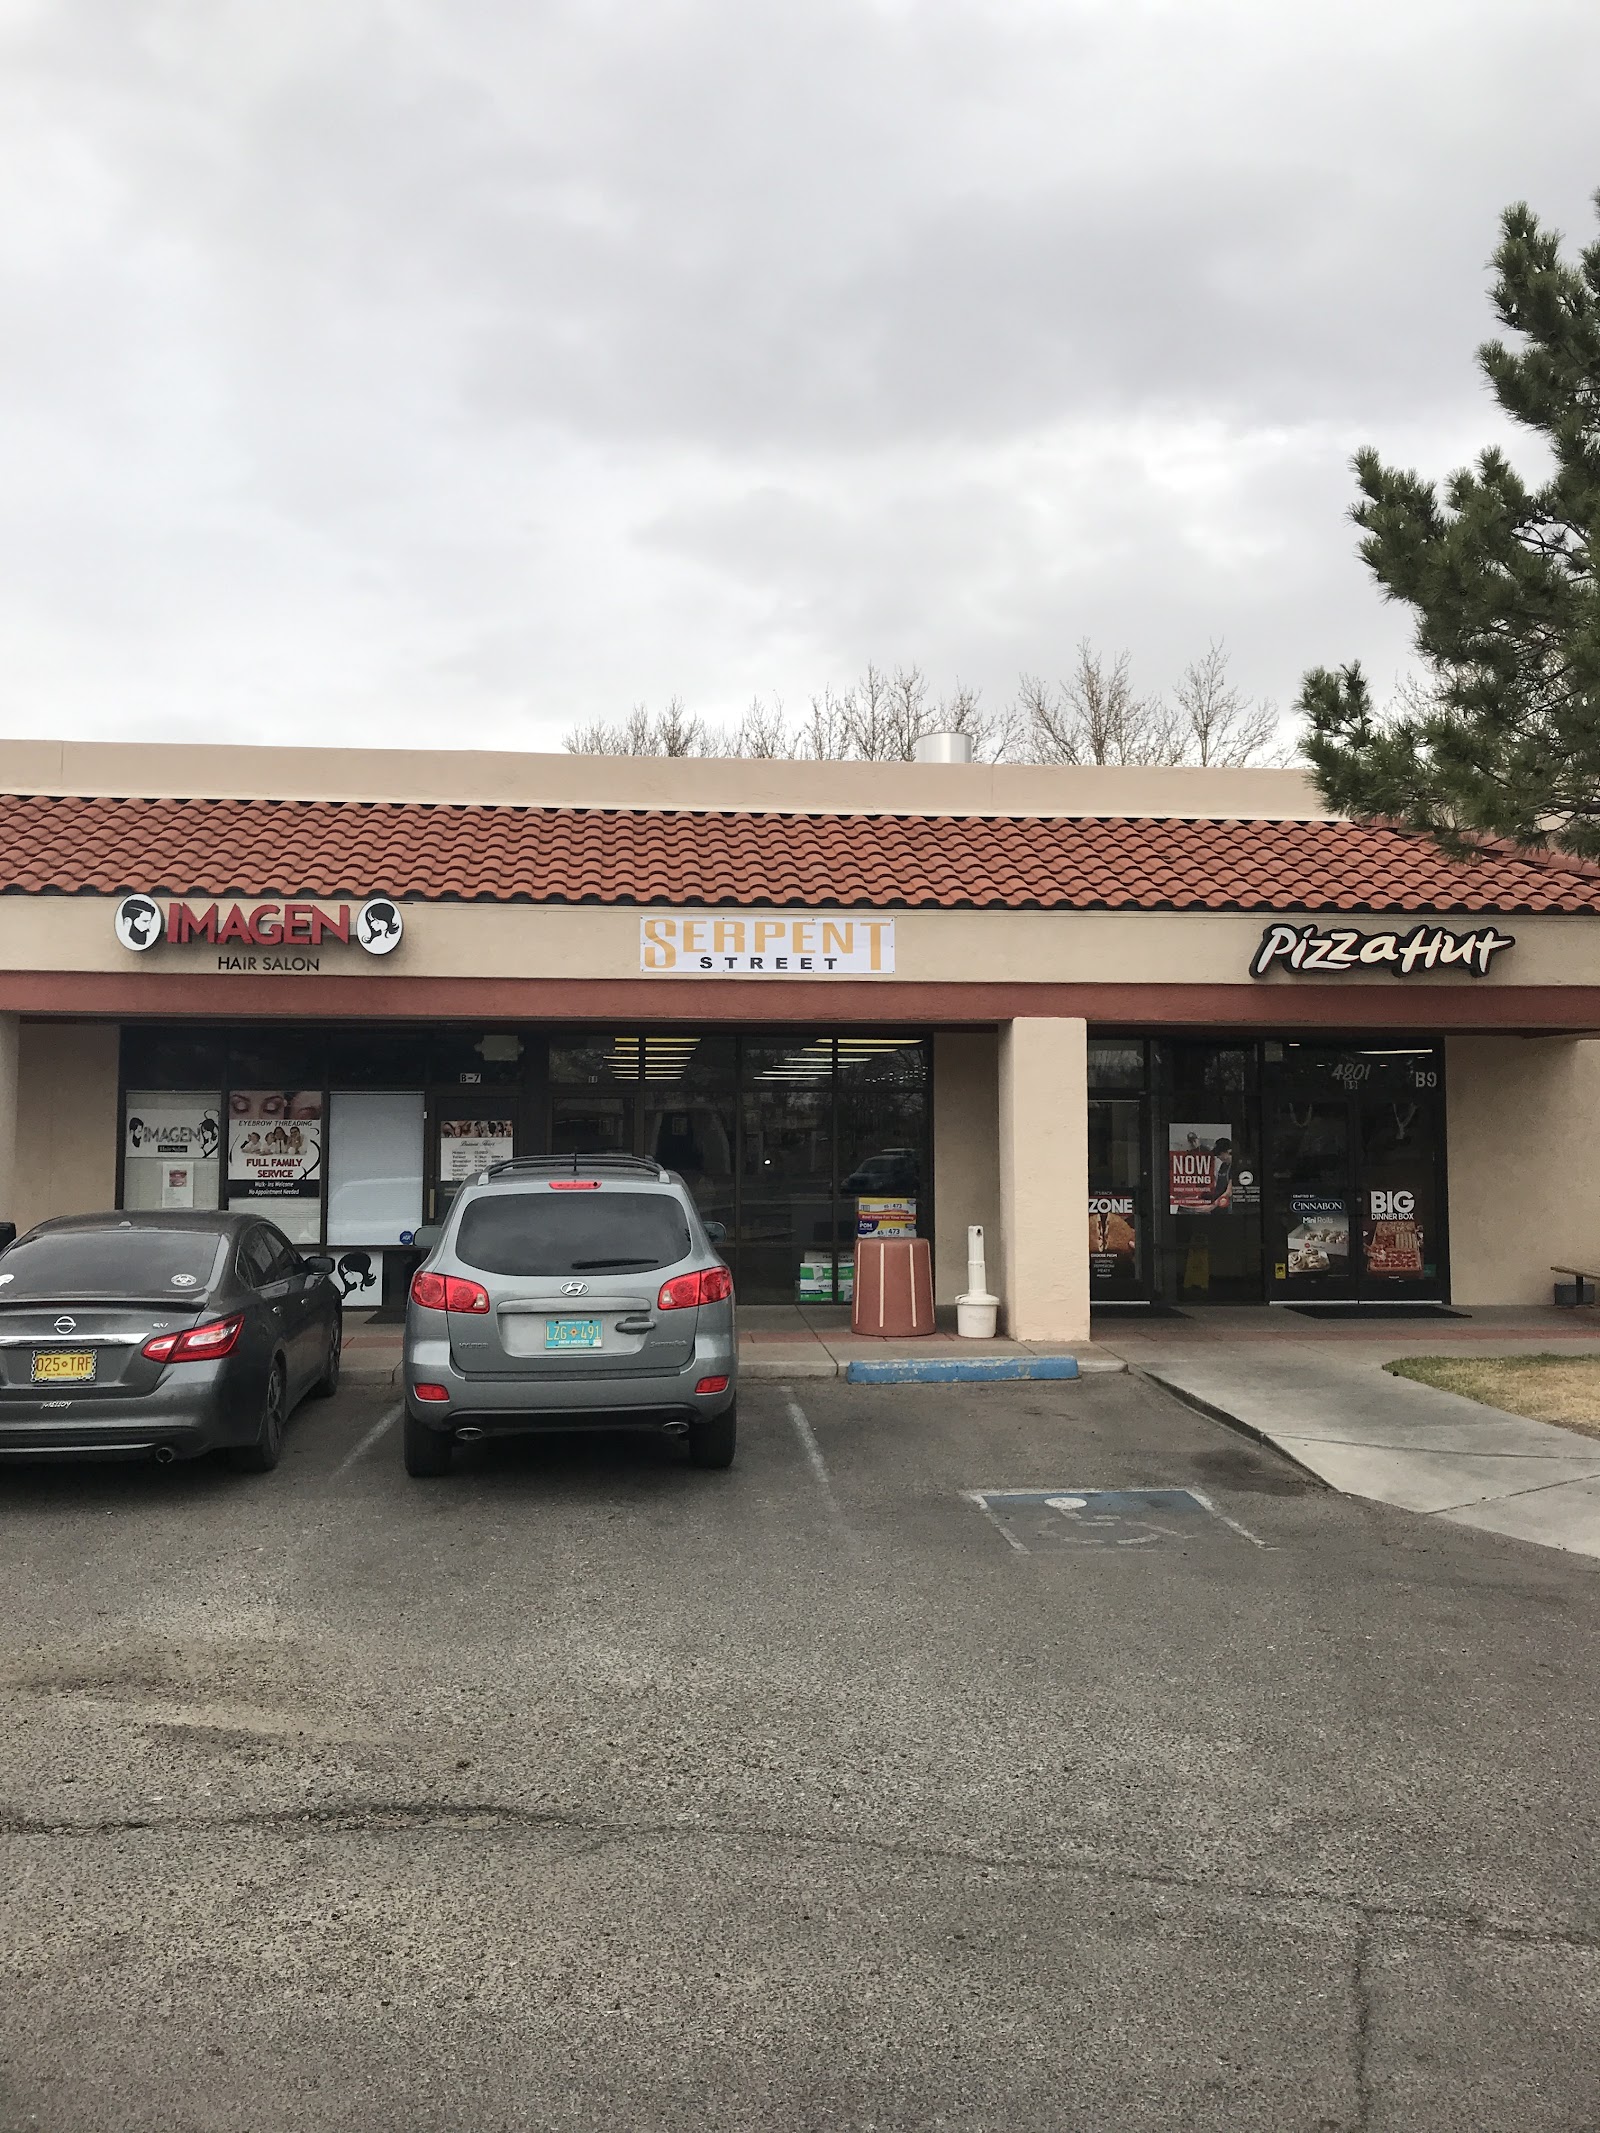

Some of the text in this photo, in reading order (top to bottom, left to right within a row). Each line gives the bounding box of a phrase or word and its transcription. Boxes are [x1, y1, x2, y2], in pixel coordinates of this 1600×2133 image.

[167, 902, 351, 946] IMAGEN
[644, 919, 891, 970] SERPENT
[1255, 927, 1512, 974] Pizza Hut
[218, 956, 320, 972] HAIR SALON
[700, 956, 838, 970] STREET
[461, 1073, 481, 1083] B-7
[1331, 1063, 1372, 1081] 4801
[1415, 1071, 1438, 1088] B9
[143, 1126, 201, 1144] IMAGEN
[246, 1158, 303, 1167] FULL FAMILY
[1173, 1155, 1211, 1175] NOW
[257, 1169, 294, 1178] SERVICE
[1173, 1175, 1211, 1184] HIRING
[1089, 1198, 1132, 1214] ZONE
[1292, 1201, 1342, 1211] CINNABON
[1370, 1190, 1415, 1214] BIG
[1371, 1212, 1414, 1221] DINNER BOX
[546, 1325, 601, 1341] LZG 491
[36, 1356, 92, 1371] 025 TRF
